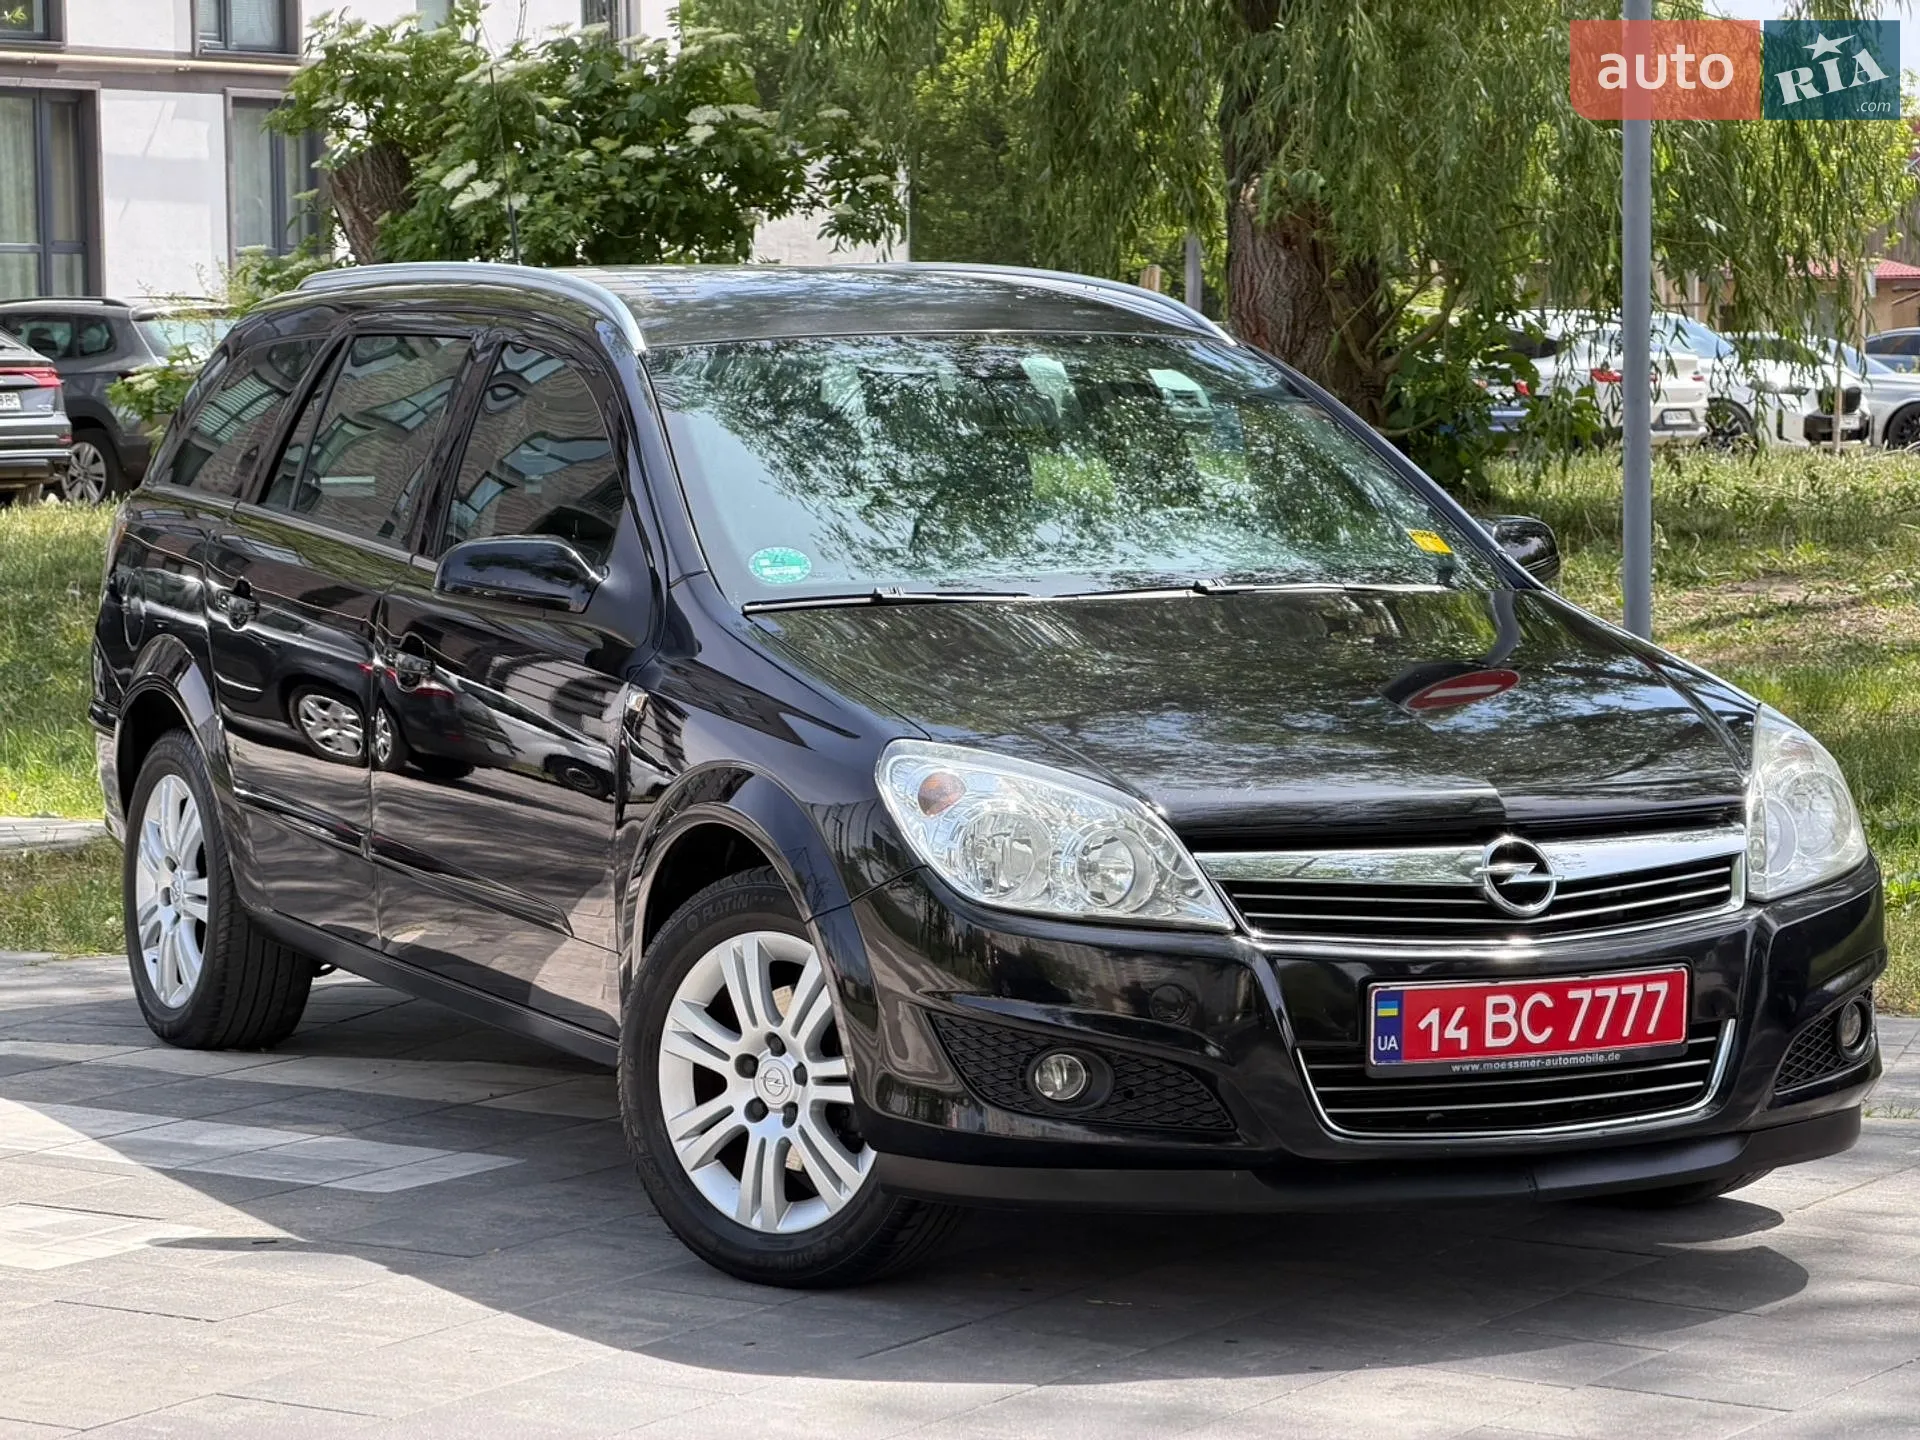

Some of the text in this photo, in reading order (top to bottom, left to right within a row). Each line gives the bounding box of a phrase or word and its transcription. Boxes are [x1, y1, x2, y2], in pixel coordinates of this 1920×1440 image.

[1417, 981, 1669, 1052] 14 BC 7777
[1377, 1035, 1399, 1052] UA
[1450, 1052, 1621, 1073] www.moessmer-automobile.de
